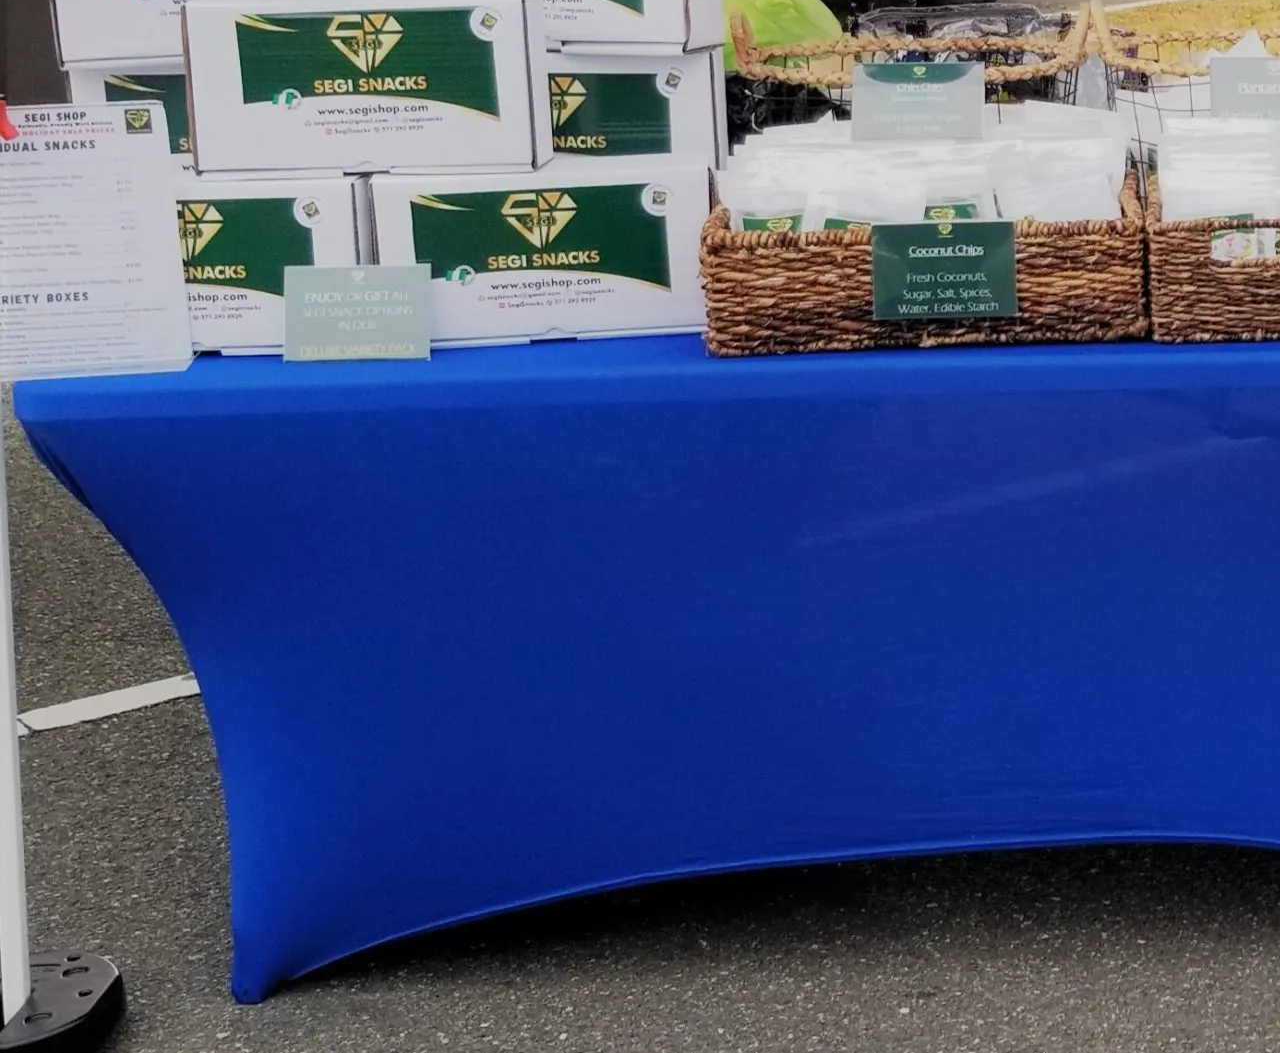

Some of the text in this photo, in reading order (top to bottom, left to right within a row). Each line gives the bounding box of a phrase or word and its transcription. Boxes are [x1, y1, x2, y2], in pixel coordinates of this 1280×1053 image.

[313, 76, 428, 93] SEGI SNACKS
[24, 111, 87, 123] SEGI SHOP
[317, 104, 429, 117] www.segishop.com
[0, 139, 96, 153] DUAL SNACKS
[553, 135, 607, 149] NACKS
[908, 244, 985, 257] Coconut Chips
[488, 250, 601, 269] SEGI SNACKS
[490, 277, 601, 291] www.segishop.com
[907, 272, 988, 284] Fresh Coconuts,
[1, 291, 89, 305] RIETY BOXES
[903, 288, 993, 301] Sugar, Salt, Spices,
[897, 301, 999, 314] Water, Edible Starch
